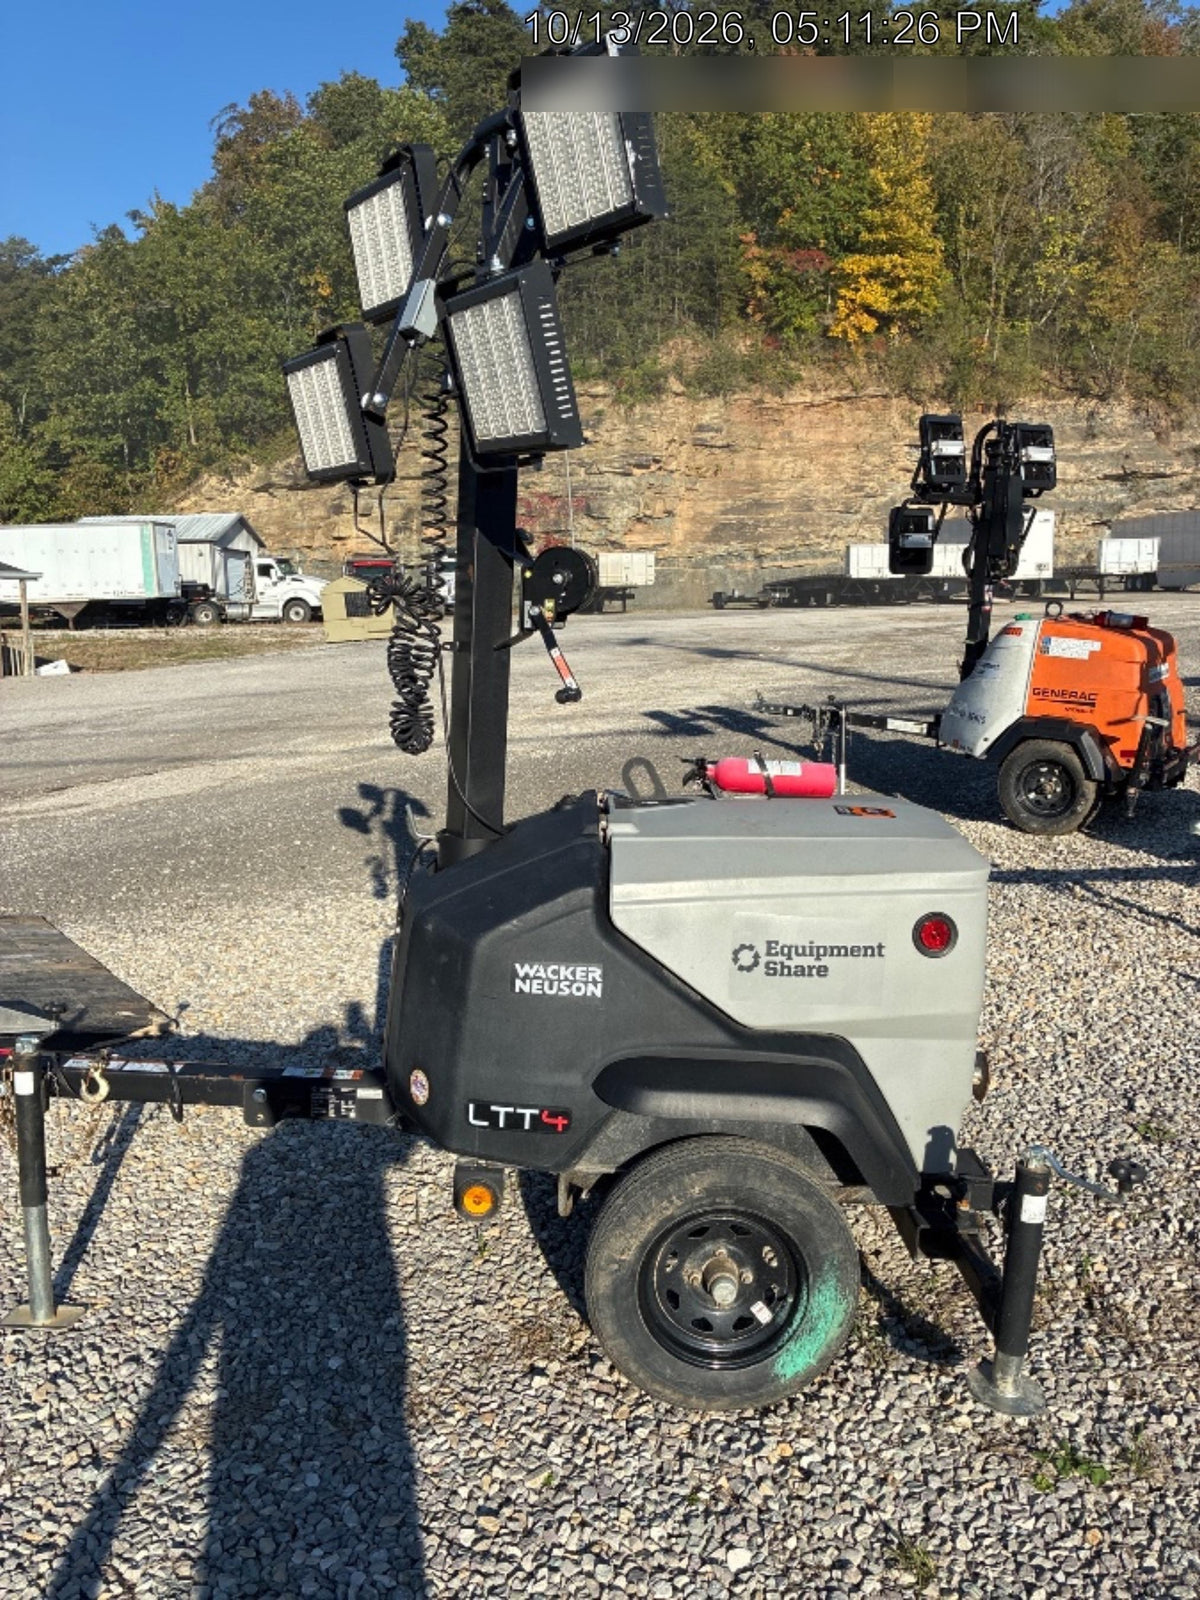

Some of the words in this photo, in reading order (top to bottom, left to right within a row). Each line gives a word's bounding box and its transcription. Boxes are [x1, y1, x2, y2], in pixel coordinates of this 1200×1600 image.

[1032, 687, 1098, 701] GENERAC
[765, 940, 885, 961] Equipment
[514, 962, 603, 982] WACKER
[764, 960, 829, 977] Share
[514, 978, 602, 998] NEUSON
[468, 1103, 569, 1134] LTT4
